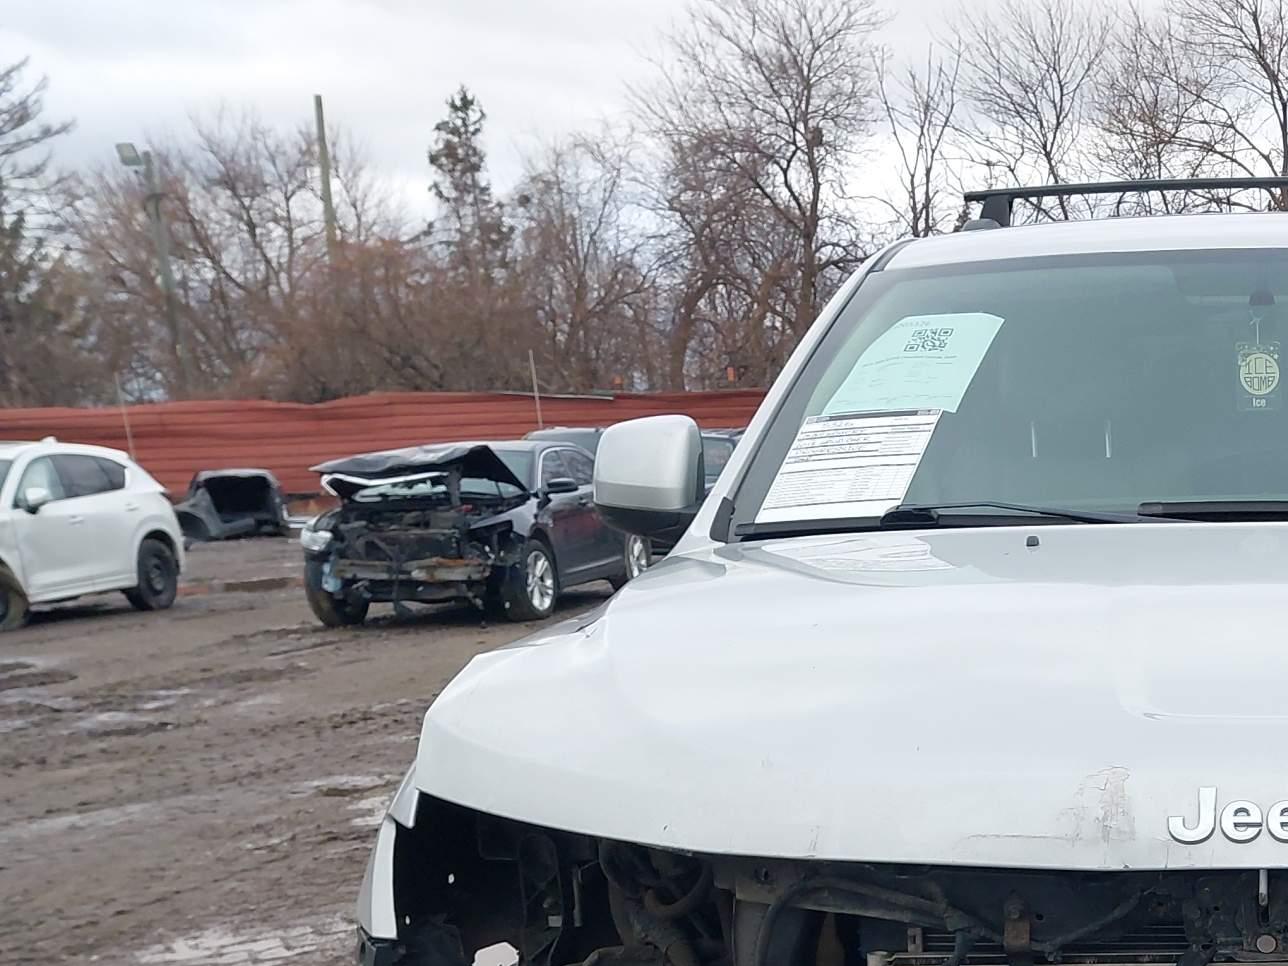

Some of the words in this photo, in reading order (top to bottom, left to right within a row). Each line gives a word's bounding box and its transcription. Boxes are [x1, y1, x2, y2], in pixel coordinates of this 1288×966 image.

[1244, 357, 1275, 375] ICE
[1244, 375, 1275, 391] BOMB
[1252, 397, 1266, 407] Ice
